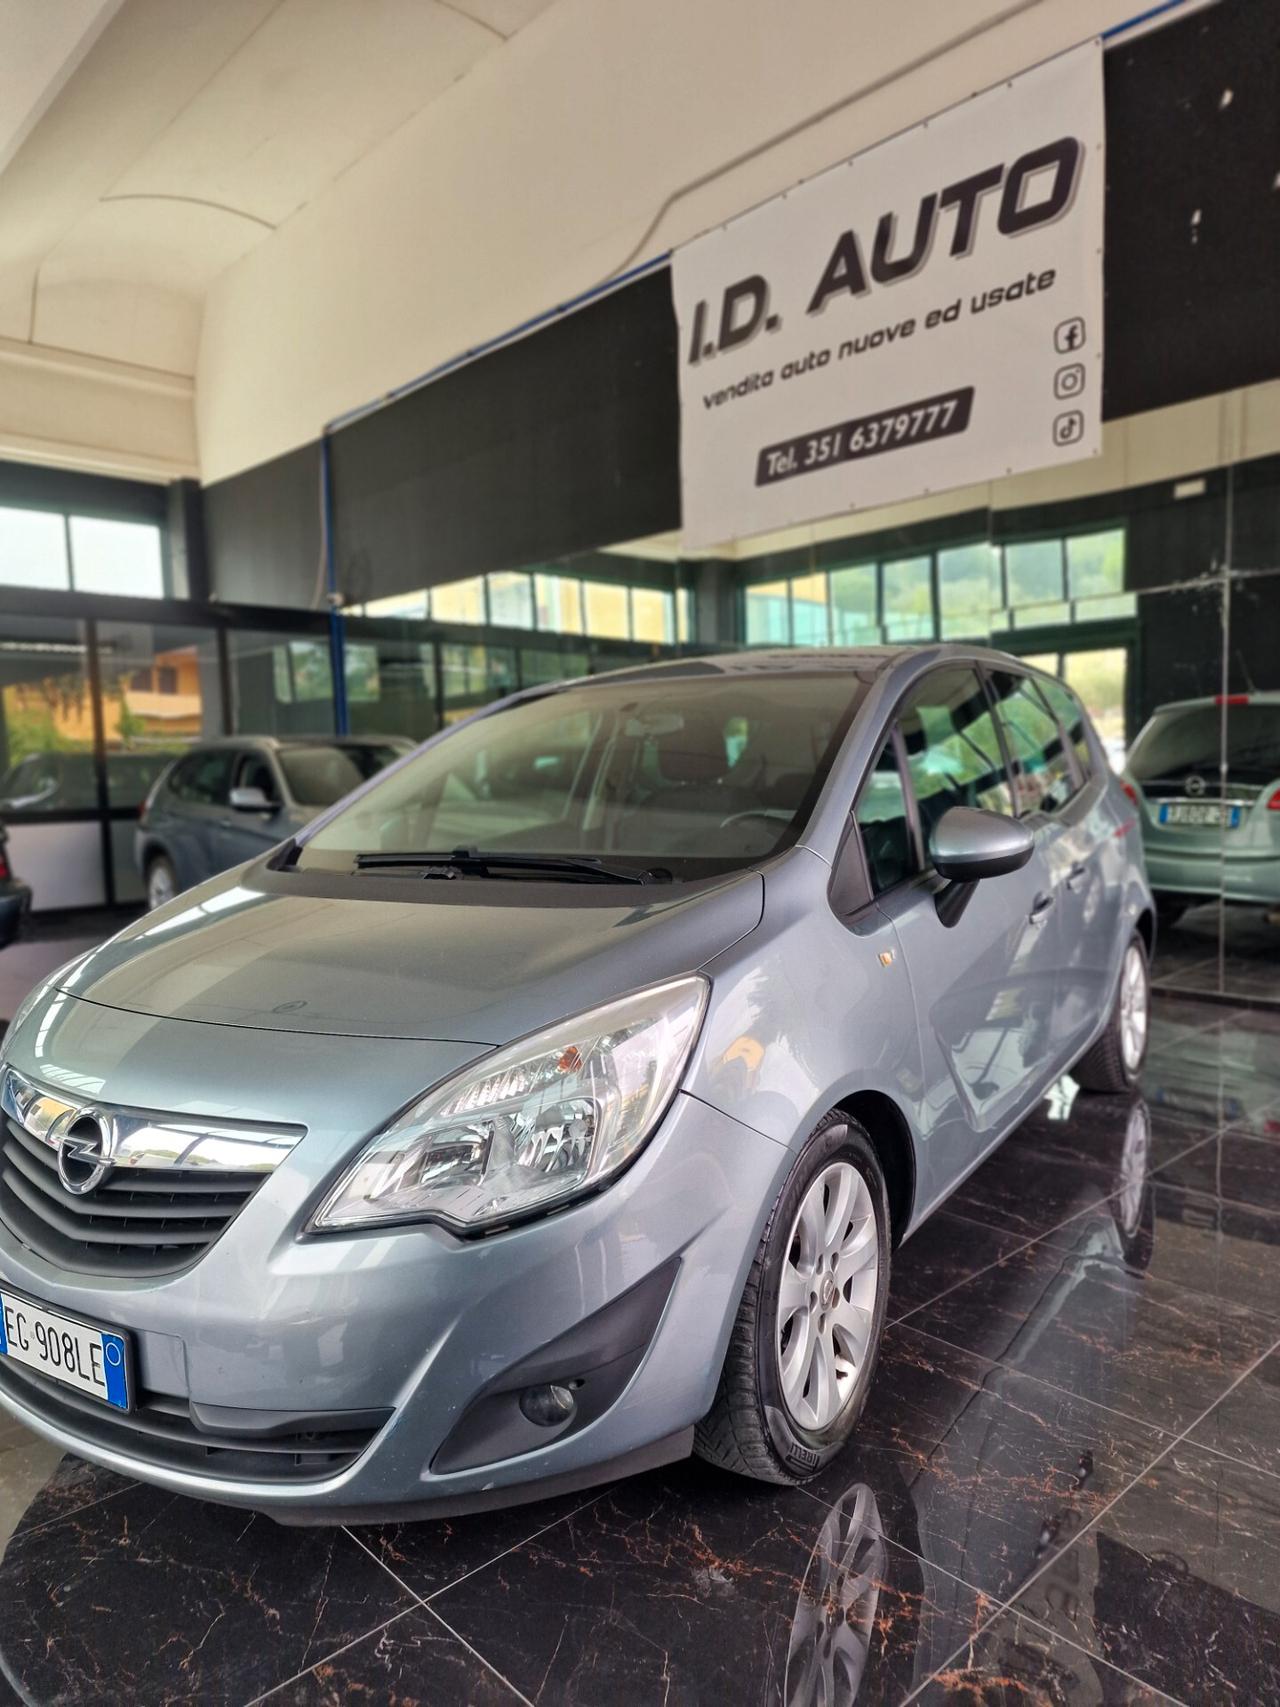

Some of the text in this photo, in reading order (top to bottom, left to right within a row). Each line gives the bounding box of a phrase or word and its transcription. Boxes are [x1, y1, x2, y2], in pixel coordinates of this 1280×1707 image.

[688, 136, 1085, 367] I.D. AUTO
[703, 269, 1056, 410] vendita auto nuove ed usate
[767, 399, 957, 477] Tel. 351 6379777
[4, 1305, 106, 1387] EG 908LE
[785, 1442, 820, 1473] PIRELLI
